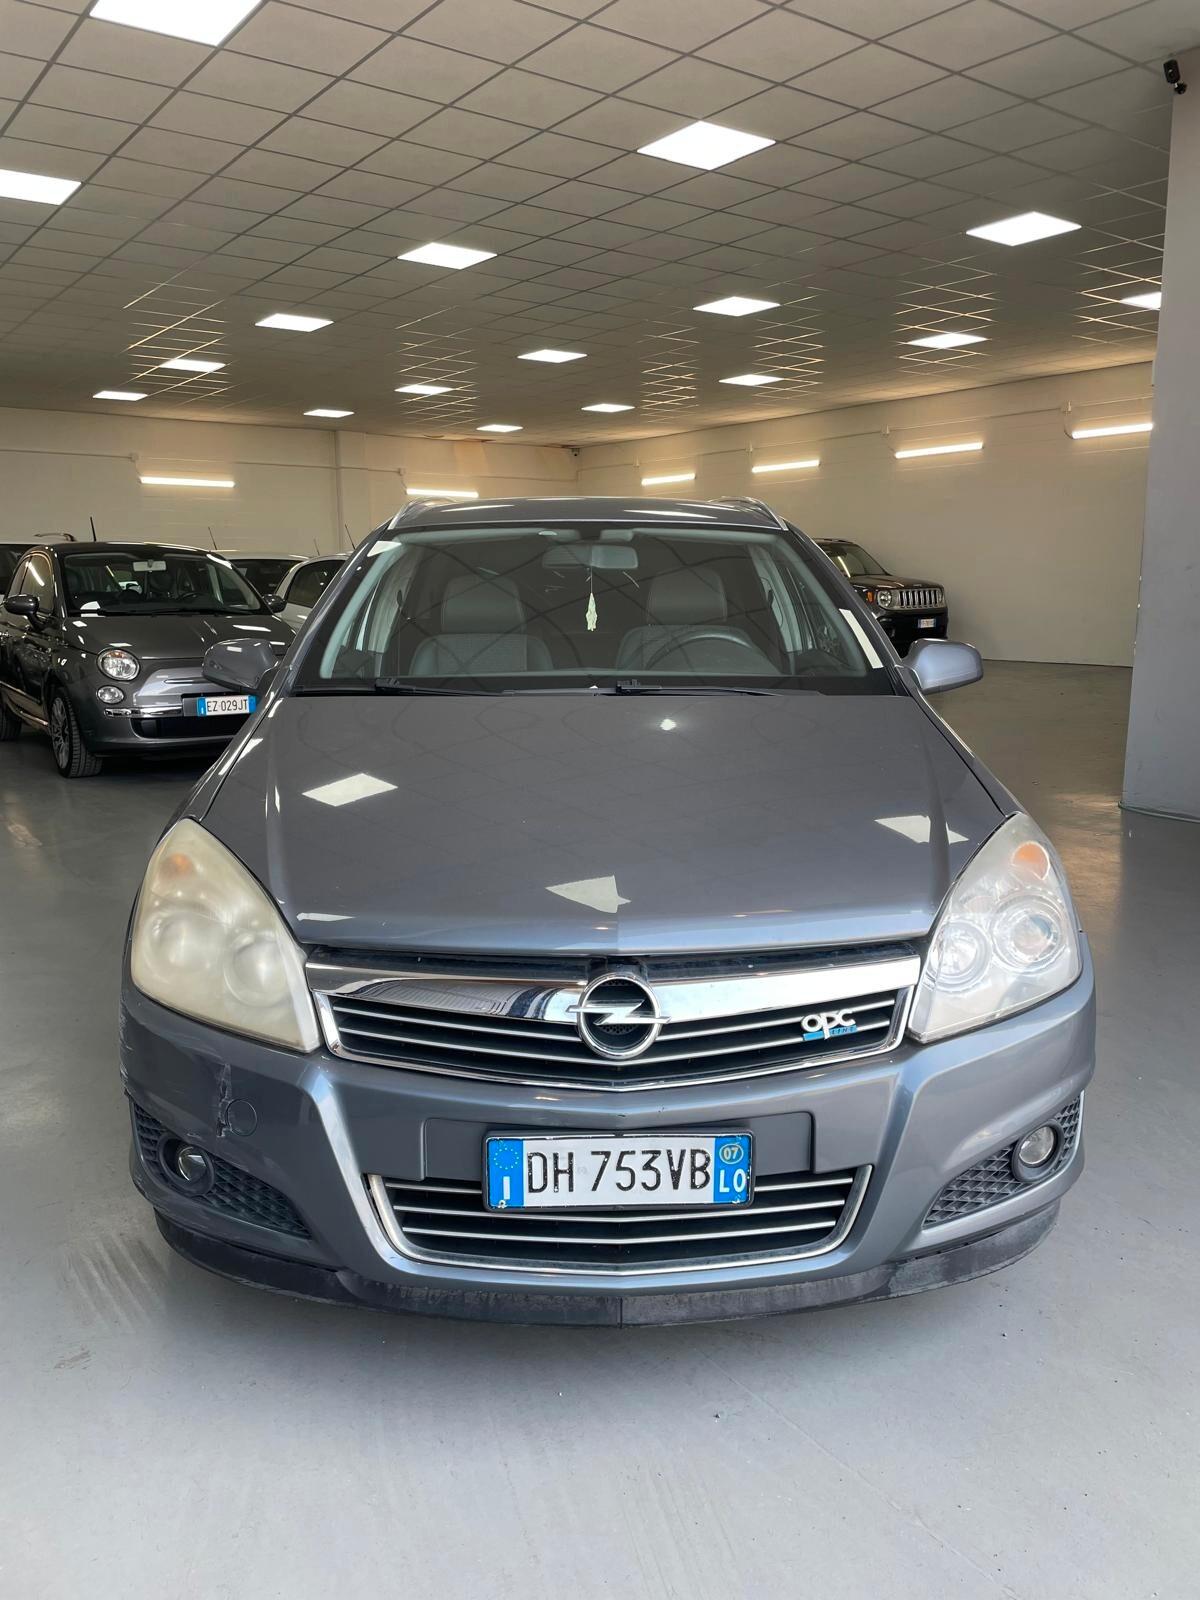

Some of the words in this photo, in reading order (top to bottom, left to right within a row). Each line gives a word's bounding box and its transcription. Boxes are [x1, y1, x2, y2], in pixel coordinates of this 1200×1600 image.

[206, 700, 218, 712] EZ
[220, 699, 248, 712] 029JT
[723, 1146, 738, 1160] 07
[527, 1151, 574, 1193] DH
[590, 1149, 711, 1192] 753VB
[719, 1168, 746, 1193] LO
